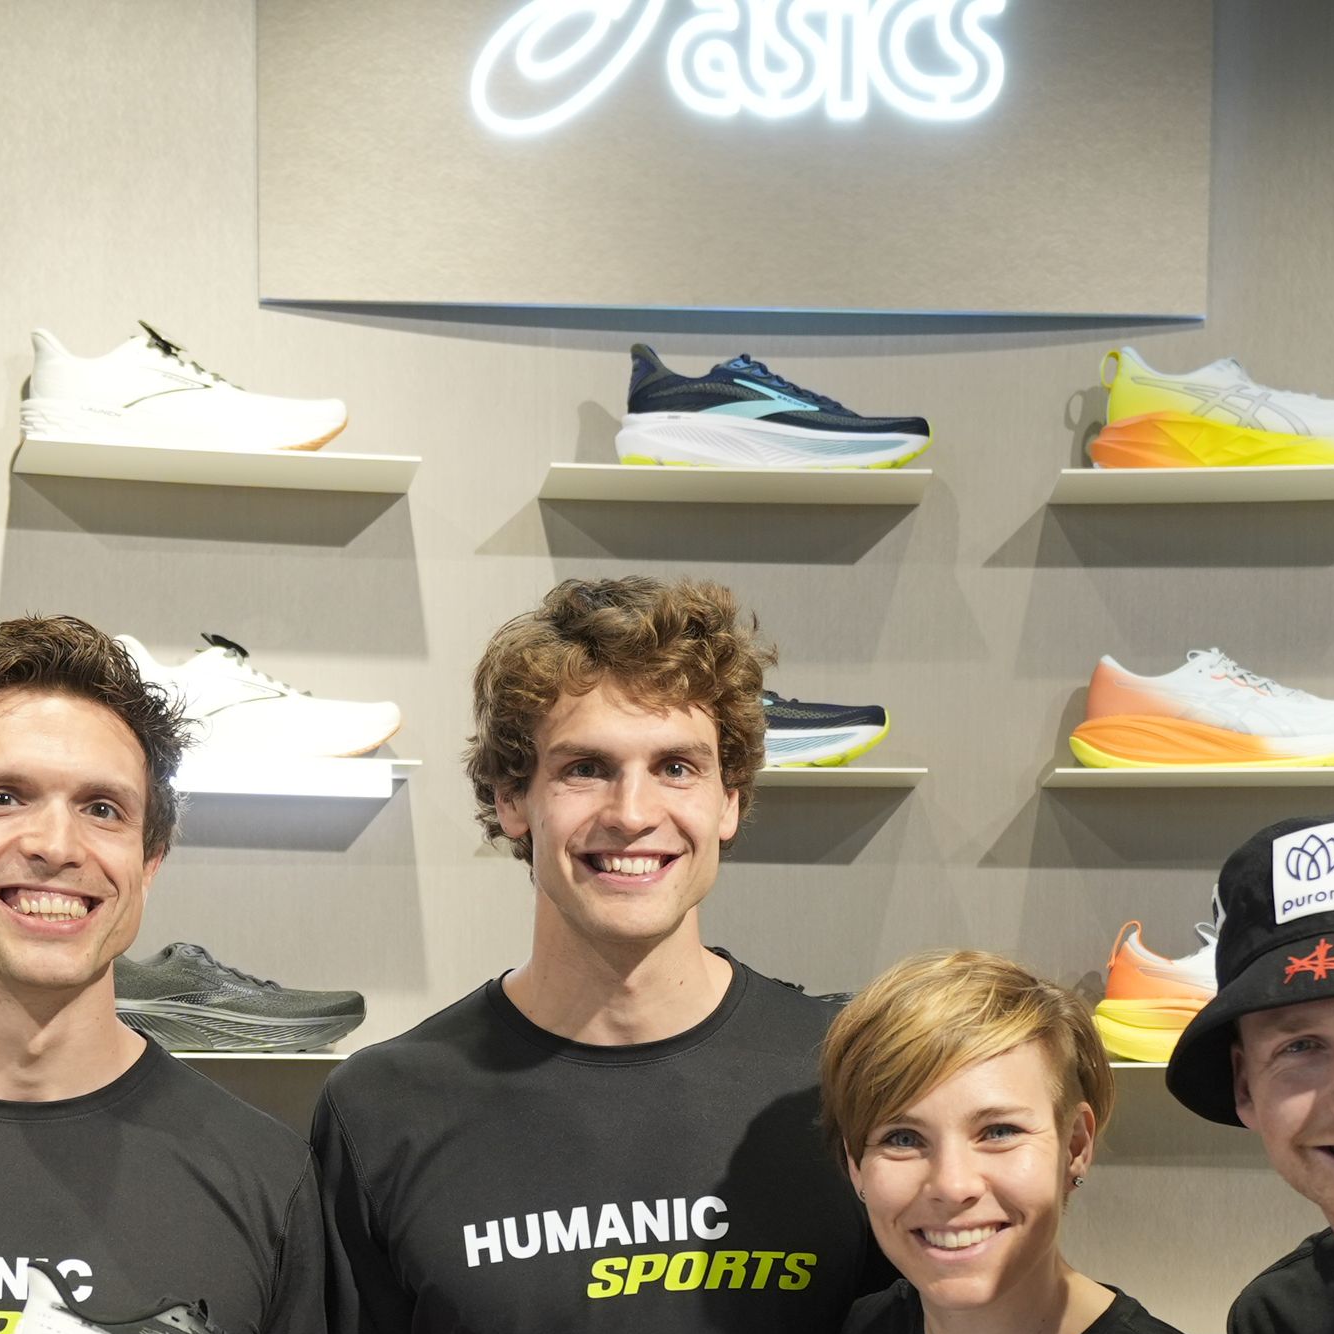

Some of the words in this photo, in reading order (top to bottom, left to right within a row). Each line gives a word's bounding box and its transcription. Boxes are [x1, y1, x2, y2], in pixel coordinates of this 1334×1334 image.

[666, 0, 1007, 121] asics
[463, 1196, 729, 1267] HUMANIC
[587, 1250, 817, 1299] SPORTS
